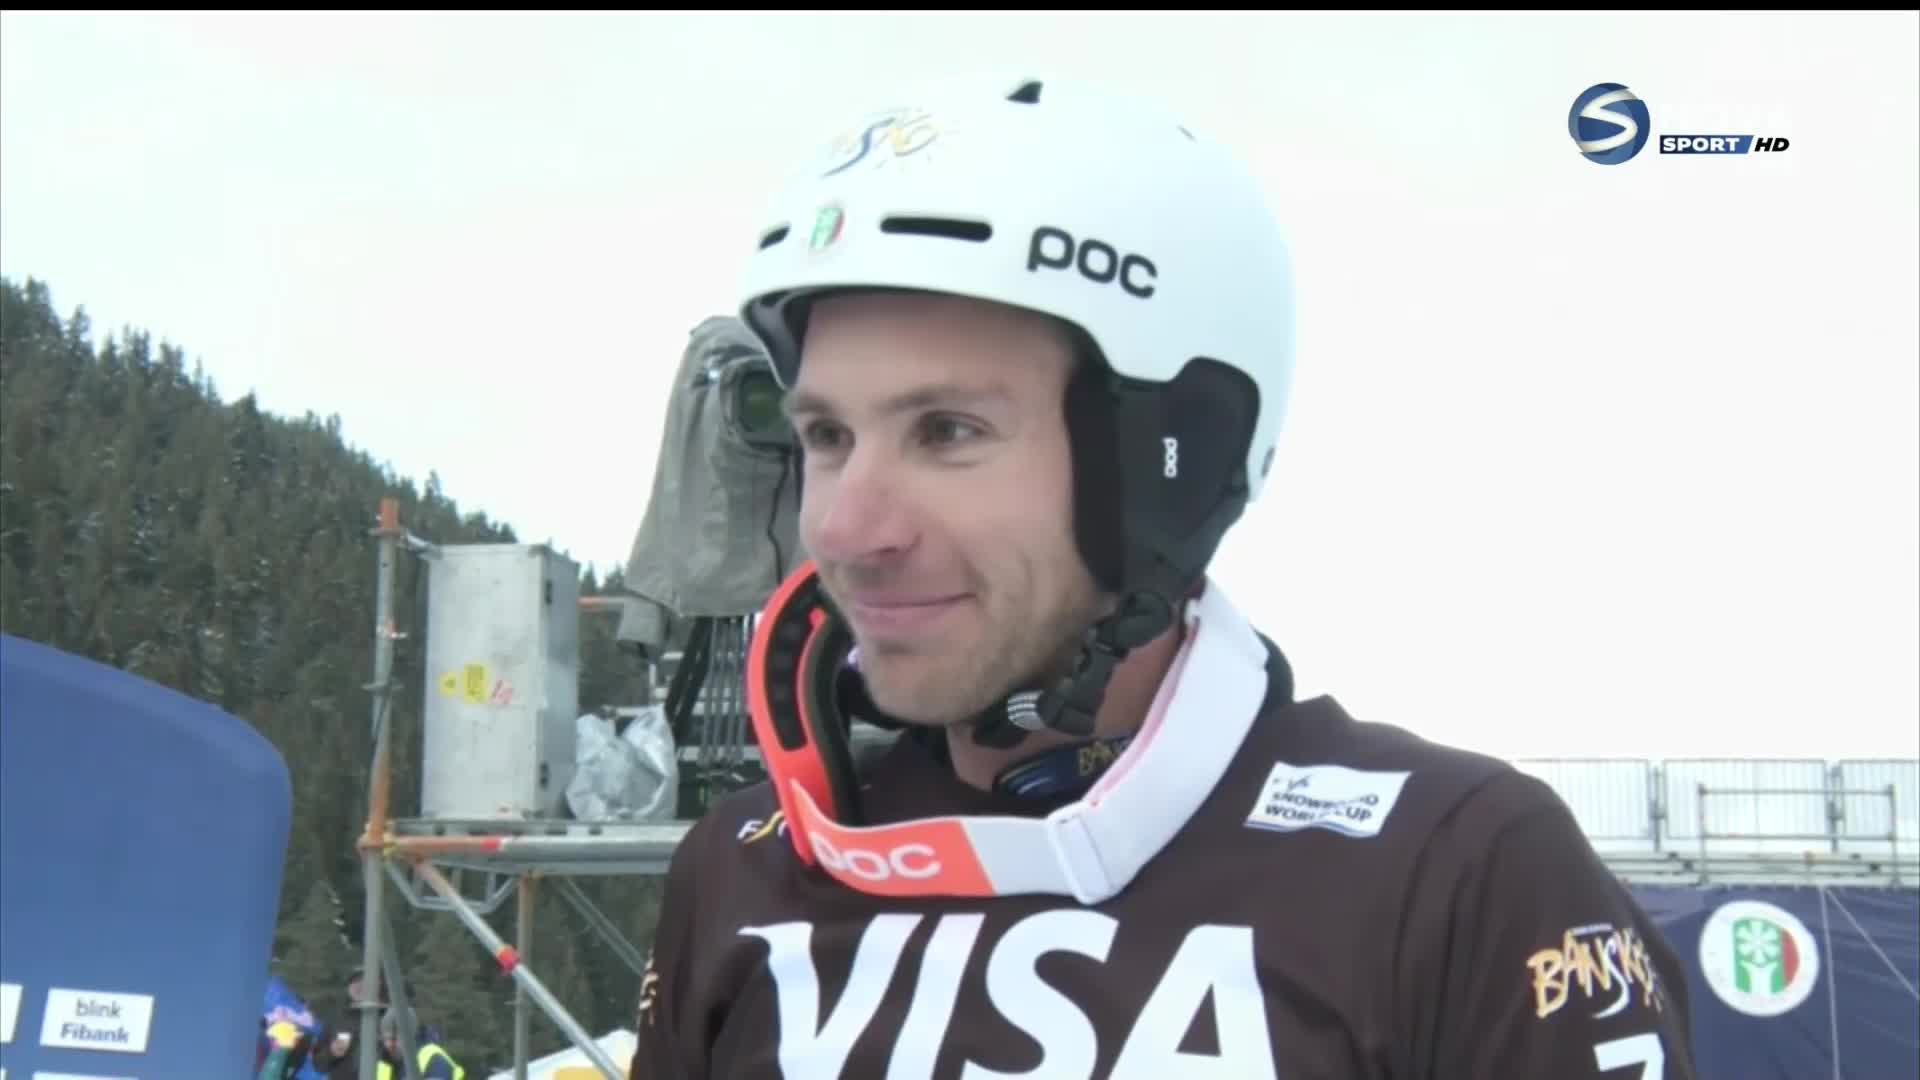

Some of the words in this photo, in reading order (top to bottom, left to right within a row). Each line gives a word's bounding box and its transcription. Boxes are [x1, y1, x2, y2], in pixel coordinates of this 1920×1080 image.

[737, 908, 1280, 1080] VISA
[75, 997, 122, 1019] blink
[60, 1022, 130, 1044] Fibank
